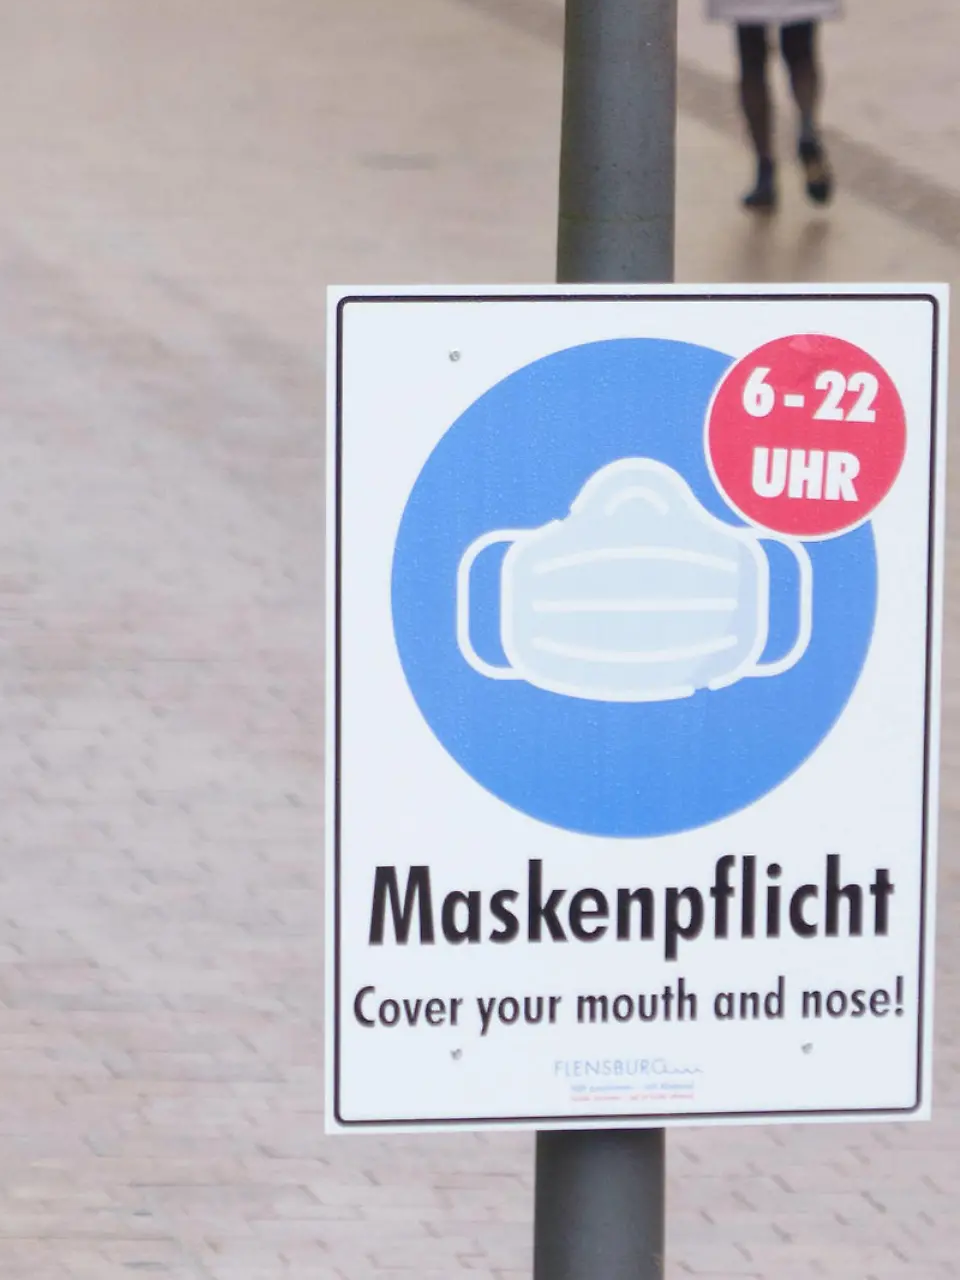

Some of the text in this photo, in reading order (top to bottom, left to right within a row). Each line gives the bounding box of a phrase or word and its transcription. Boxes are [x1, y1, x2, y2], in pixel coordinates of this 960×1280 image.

[742, 366, 879, 423] 6 - 22
[751, 446, 861, 502] UHR
[368, 853, 895, 962] Maskenpflicht
[353, 974, 905, 1037] Cover your mouth and nose!
